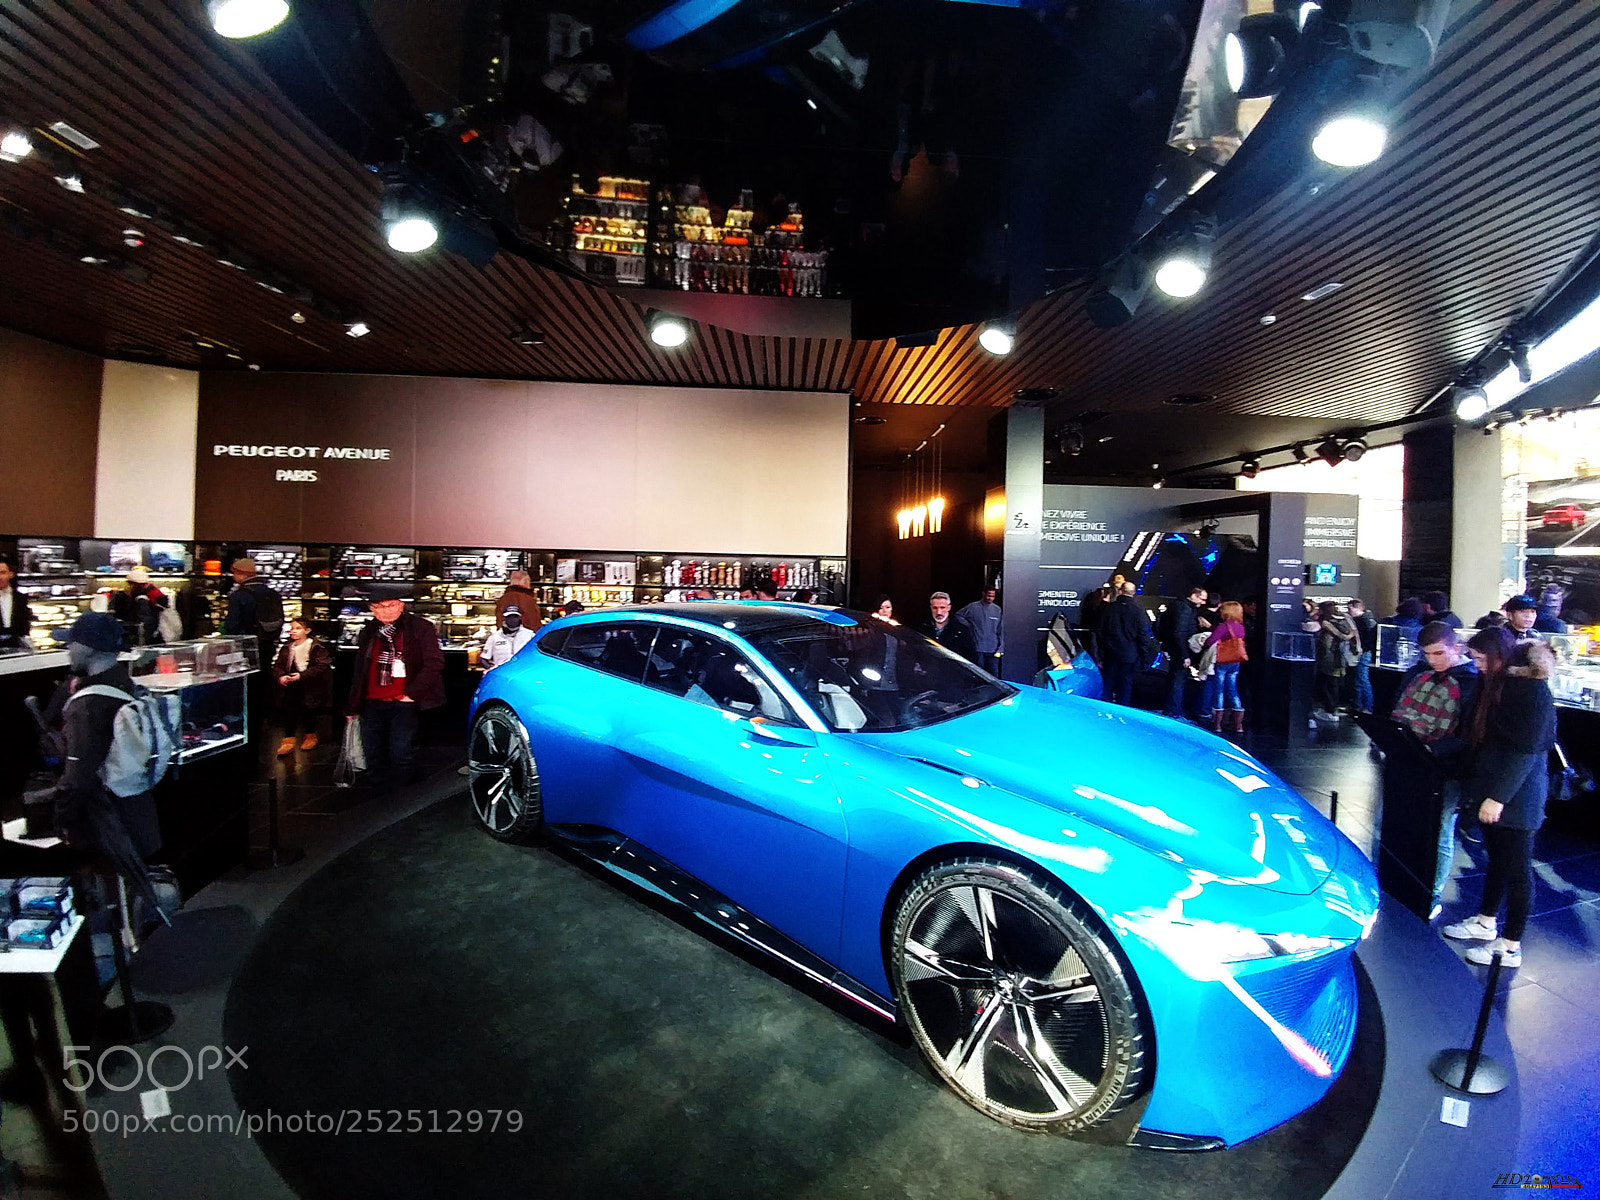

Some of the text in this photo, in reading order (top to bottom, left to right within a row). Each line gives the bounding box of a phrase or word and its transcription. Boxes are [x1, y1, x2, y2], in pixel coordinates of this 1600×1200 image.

[213, 444, 391, 460] PEUGEOT AVENUE
[275, 469, 318, 482] PARIS
[1060, 510, 1088, 519] VIVRE
[1081, 534, 1120, 543] UNIQUE
[1083, 1077, 1123, 1123] MICHELIN
